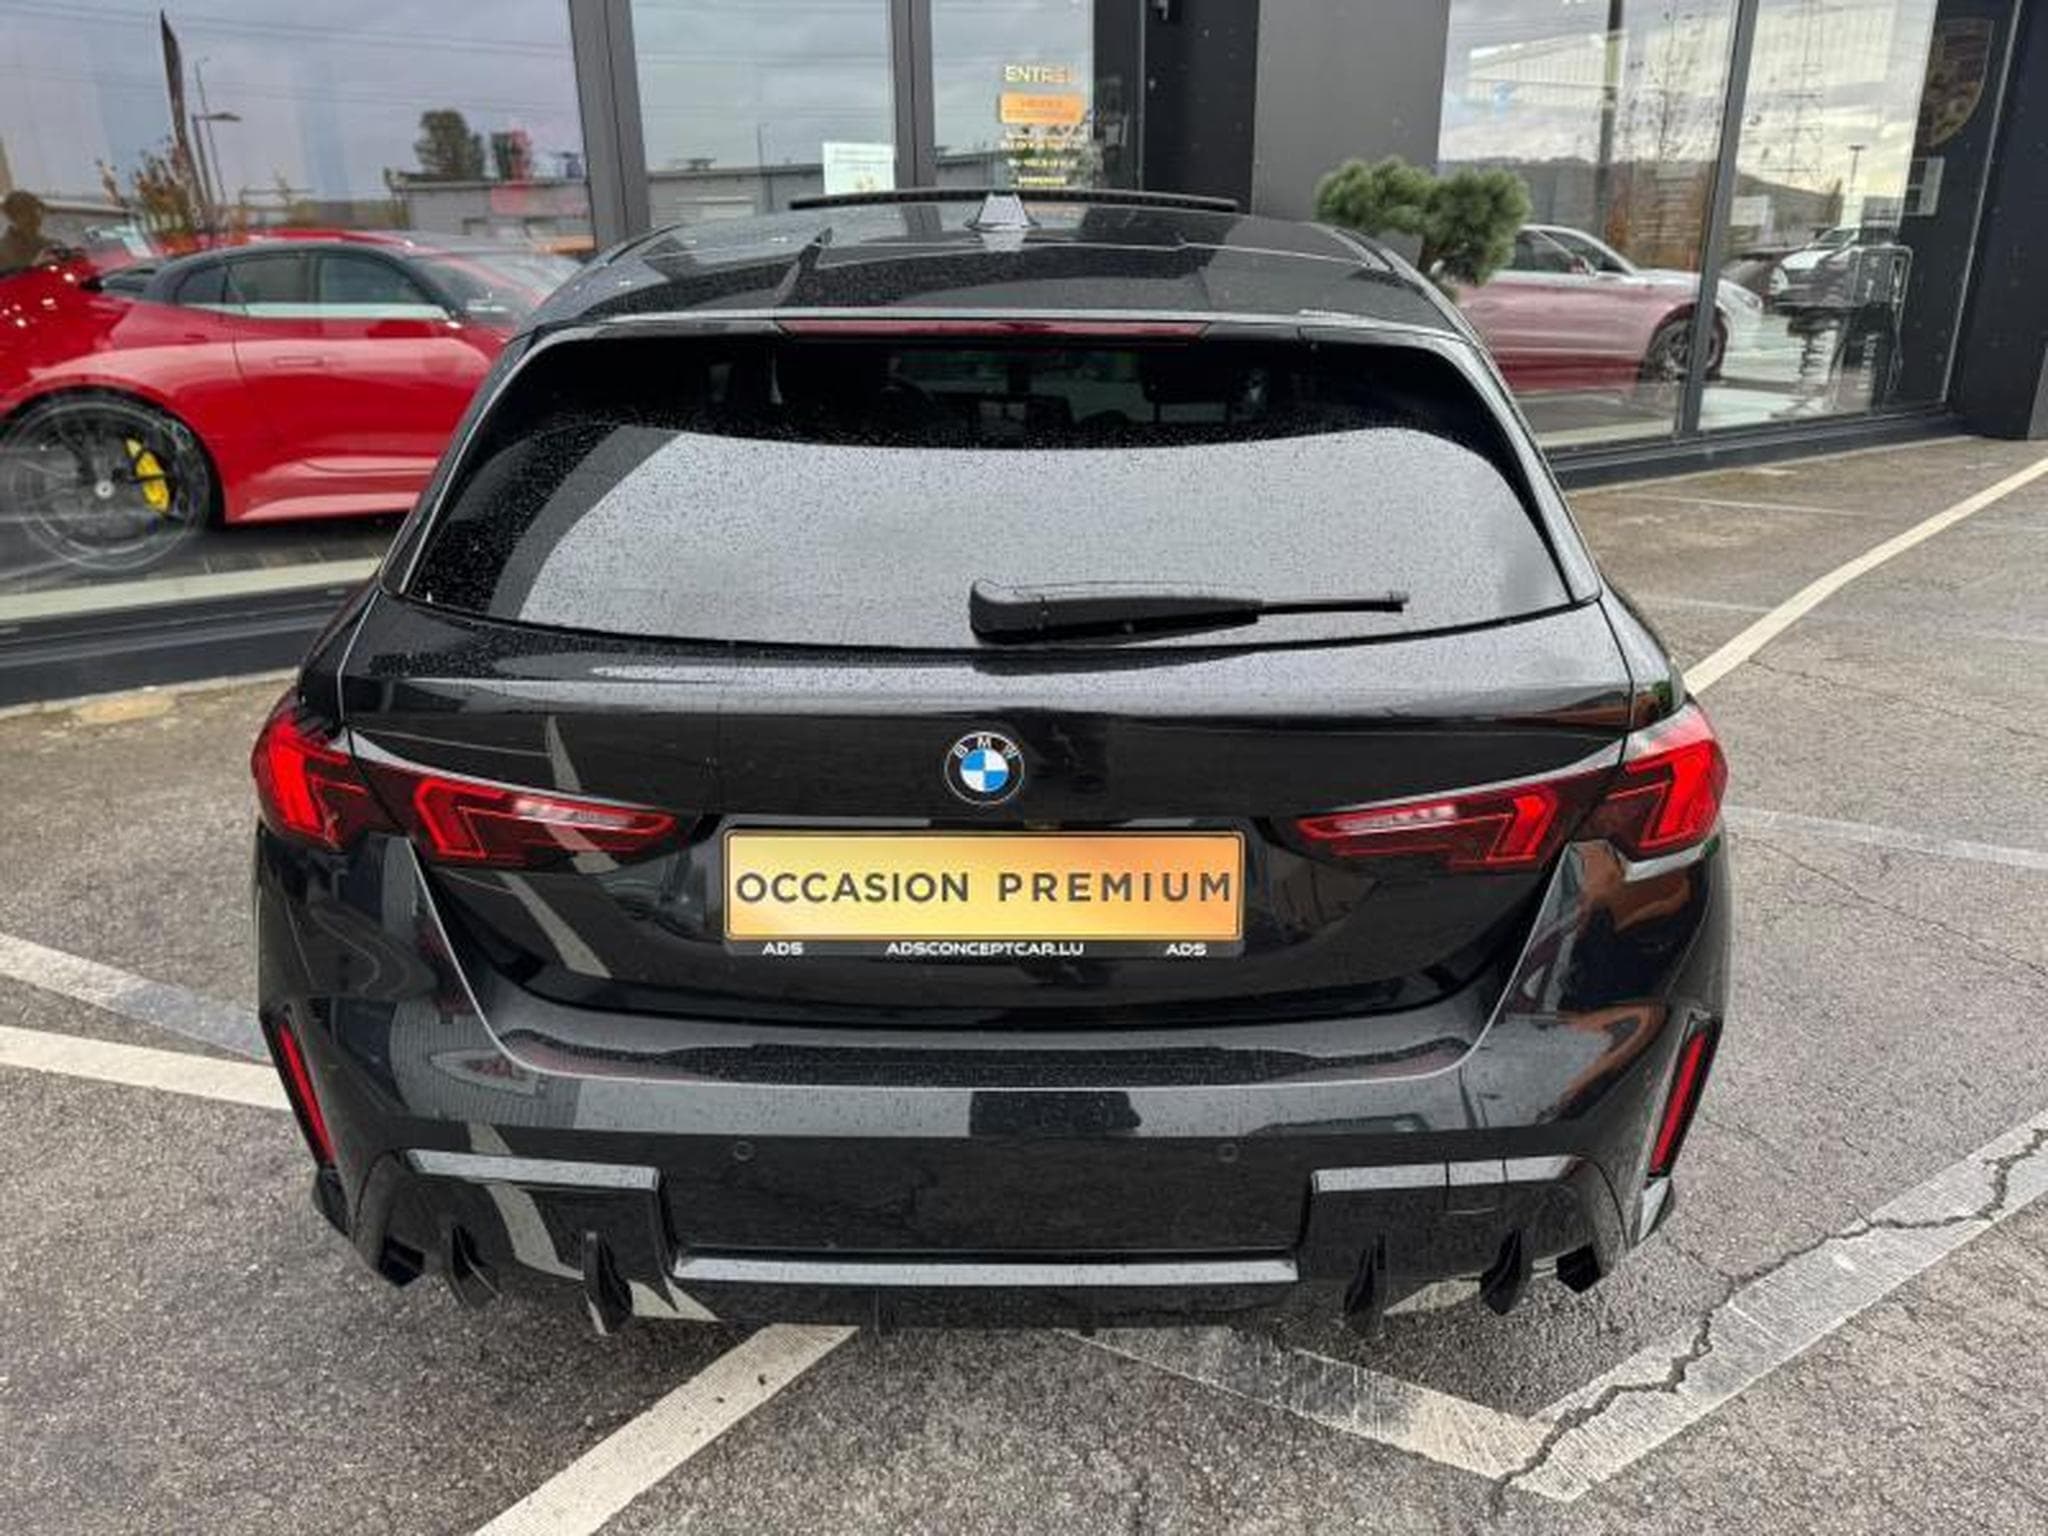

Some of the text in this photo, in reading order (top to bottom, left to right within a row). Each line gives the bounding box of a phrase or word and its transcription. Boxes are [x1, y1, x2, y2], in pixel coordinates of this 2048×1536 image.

[952, 735, 1020, 759] BMW
[736, 872, 1231, 903] OCCASION PREMIUM
[762, 942, 804, 955] ADS
[885, 942, 1084, 956] ADSCONCEPTCAR.LU
[1166, 943, 1208, 955] ADS
